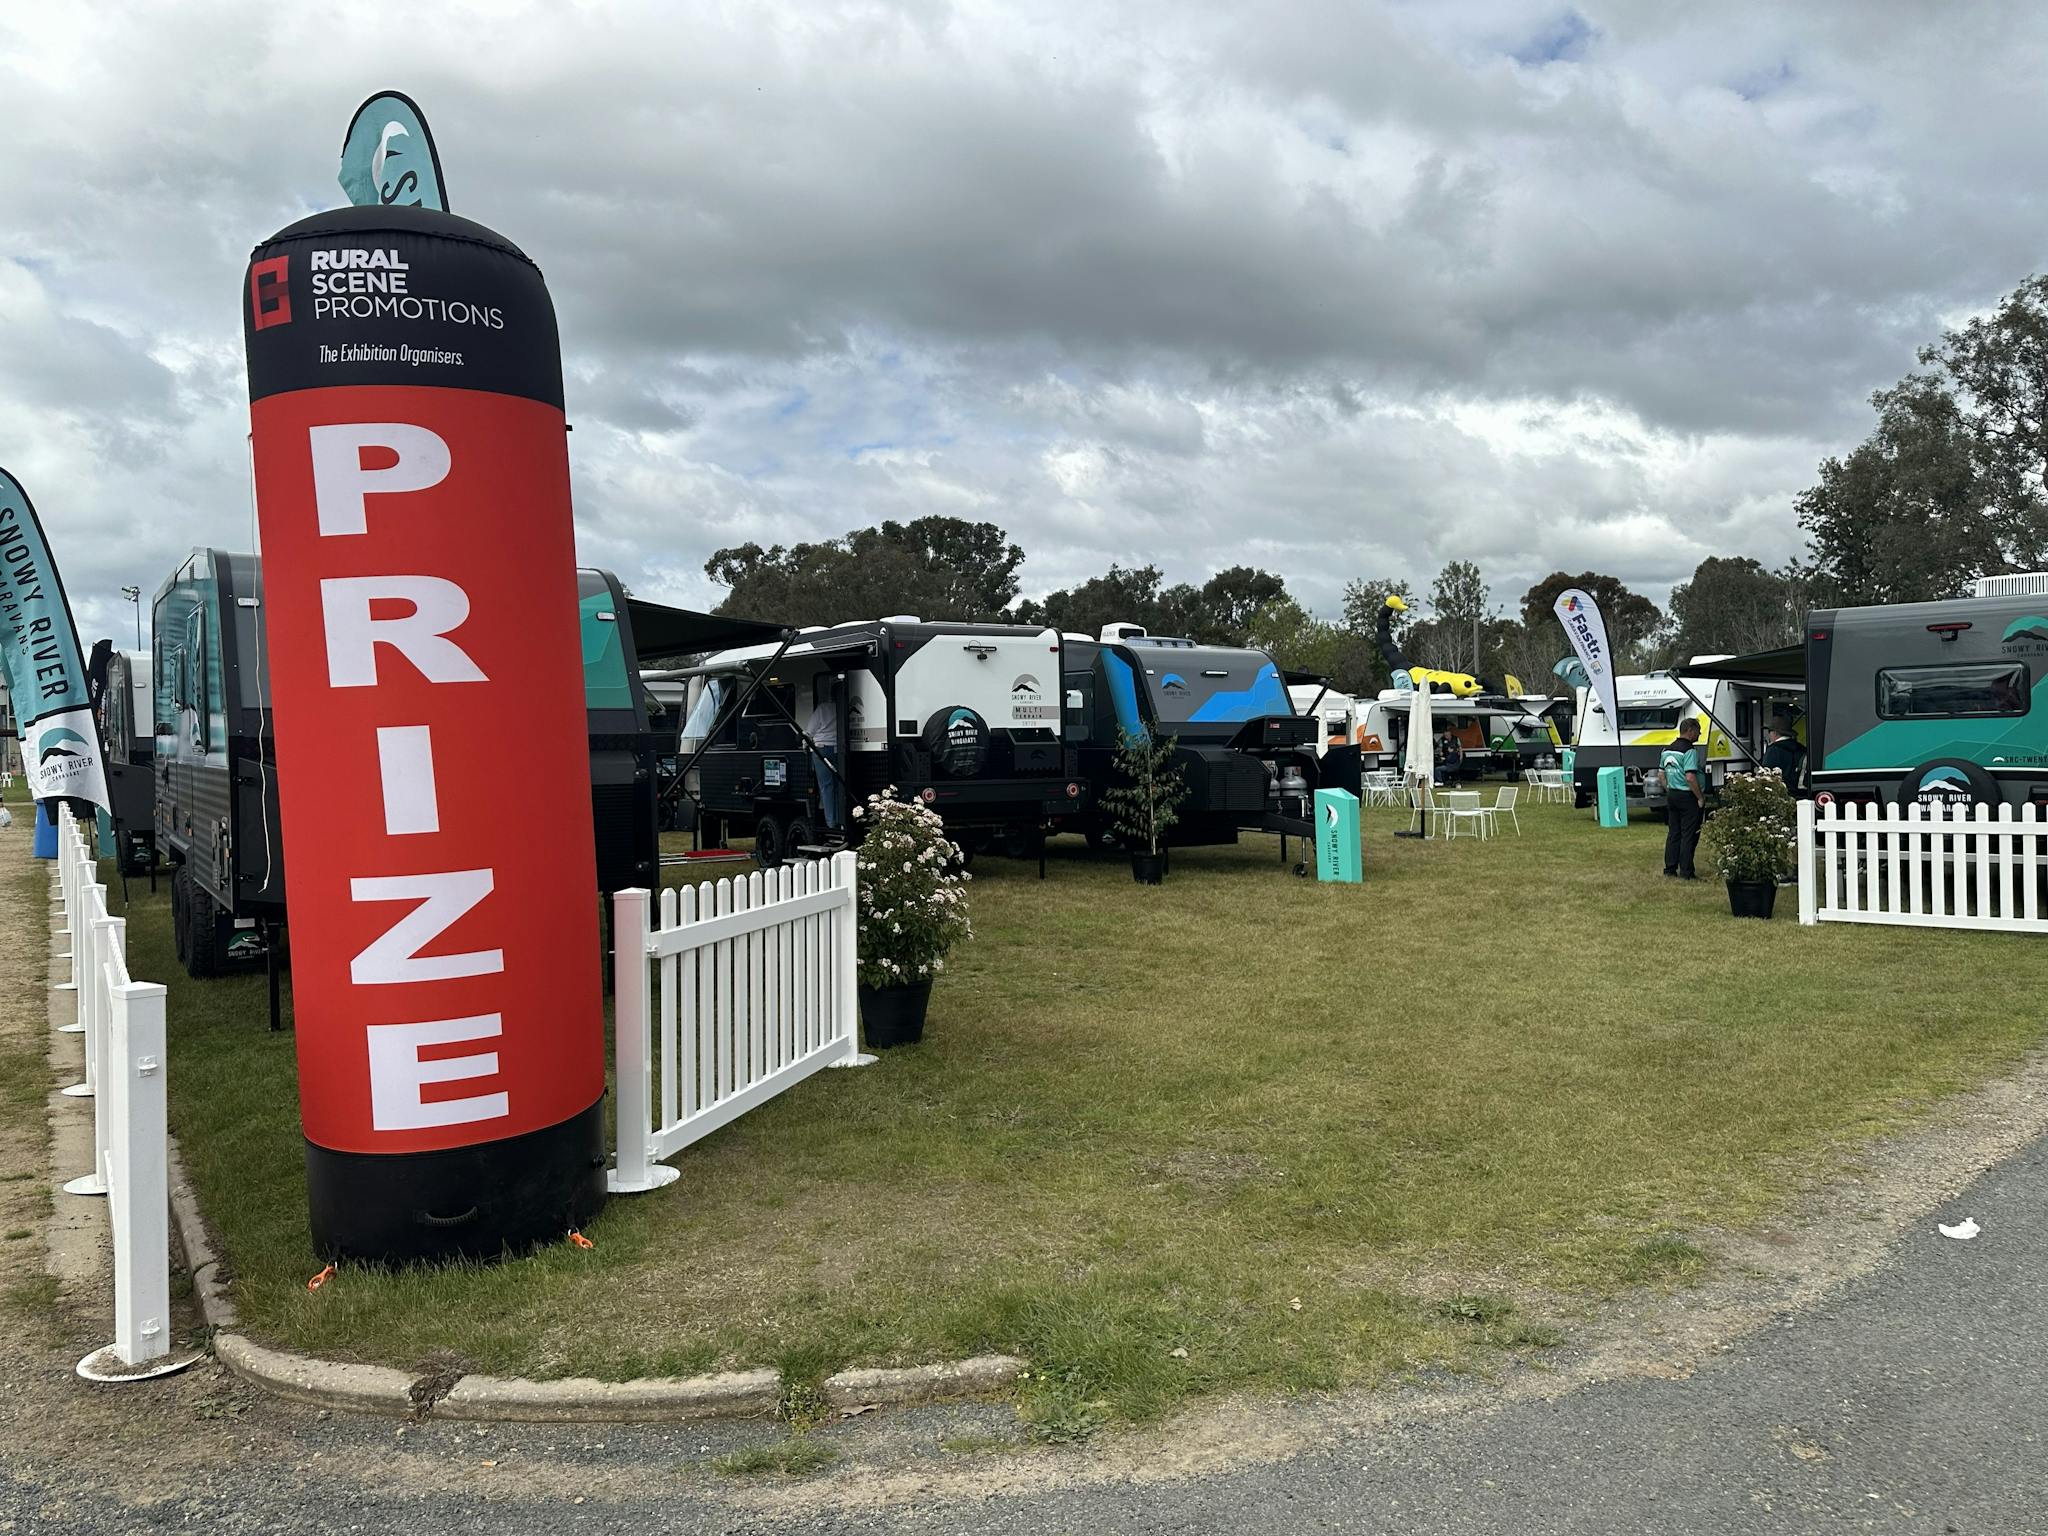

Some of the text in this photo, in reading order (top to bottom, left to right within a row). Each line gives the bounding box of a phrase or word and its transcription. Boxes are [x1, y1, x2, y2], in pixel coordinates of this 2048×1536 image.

[310, 249, 409, 271] RURAL
[312, 272, 408, 295] SCENE
[314, 296, 504, 329] PROMOTIONS
[319, 343, 465, 366] The Exhibition Organisers.
[0, 507, 69, 700] SNOWY RIVER
[0, 571, 29, 655] ARAVANS
[2035, 643, 2048, 652] RIV
[68, 757, 94, 771] RIVER
[309, 422, 508, 1130] PRIZE
[1918, 793, 1972, 802] SNOWY RIVER
